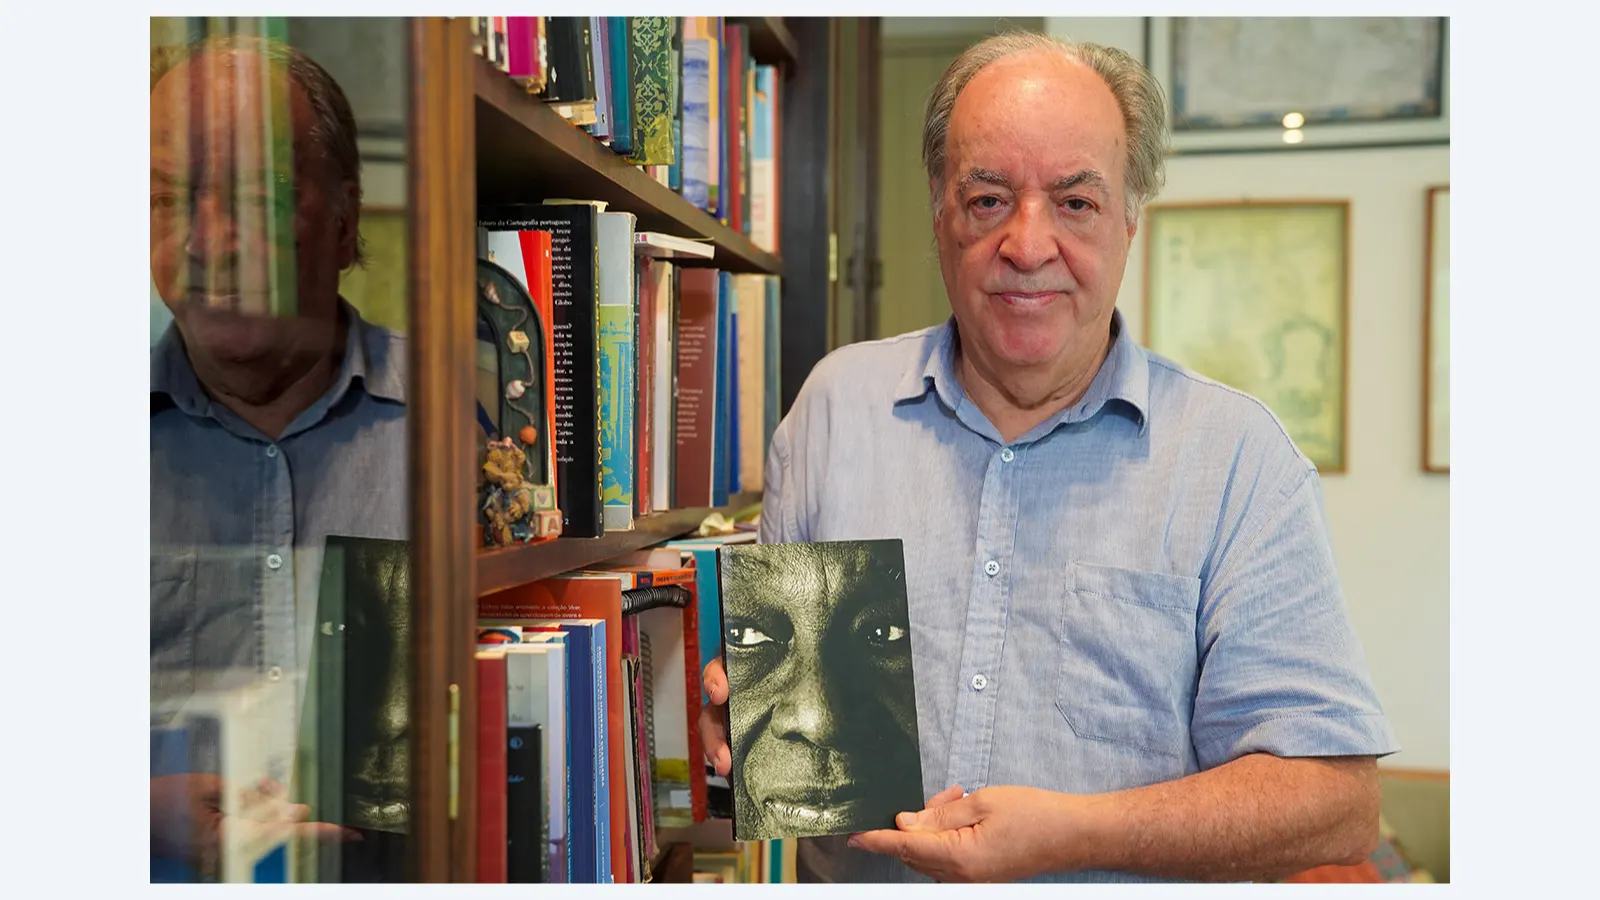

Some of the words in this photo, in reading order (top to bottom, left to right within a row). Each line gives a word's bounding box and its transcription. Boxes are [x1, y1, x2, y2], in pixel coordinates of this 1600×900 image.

[506, 218, 539, 227] Cartografia
[539, 219, 571, 227] portuguesa
[598, 471, 603, 501] OS
[564, 517, 571, 526] 2
